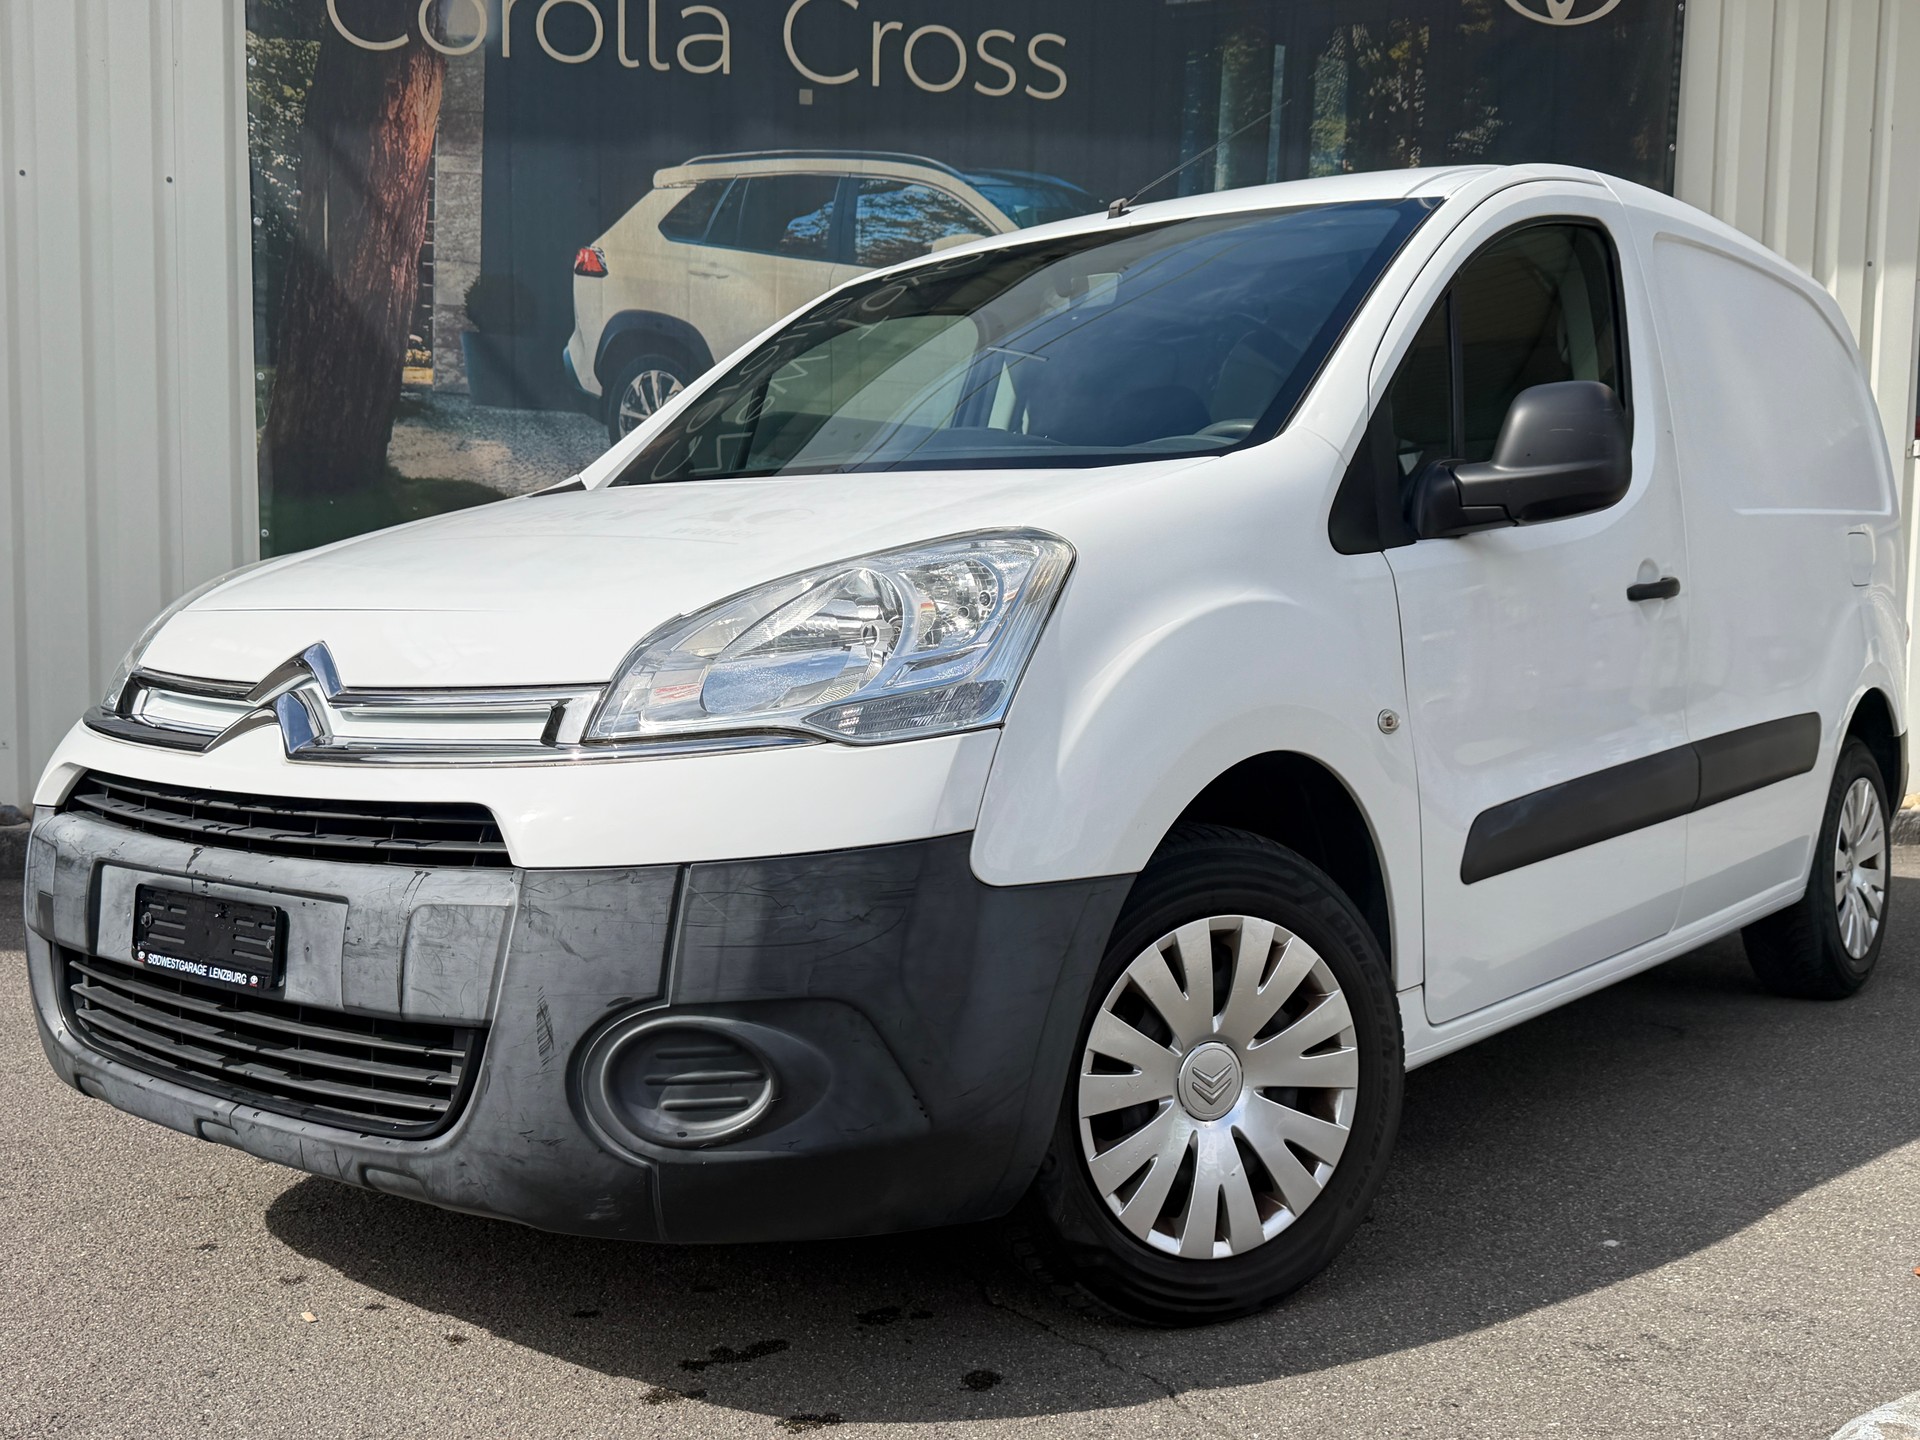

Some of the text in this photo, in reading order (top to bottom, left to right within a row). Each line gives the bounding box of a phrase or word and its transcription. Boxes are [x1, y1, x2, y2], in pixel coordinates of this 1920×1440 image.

[326, 0, 1068, 99] Corolla Cross
[209, 967, 247, 985] LENZBURG
